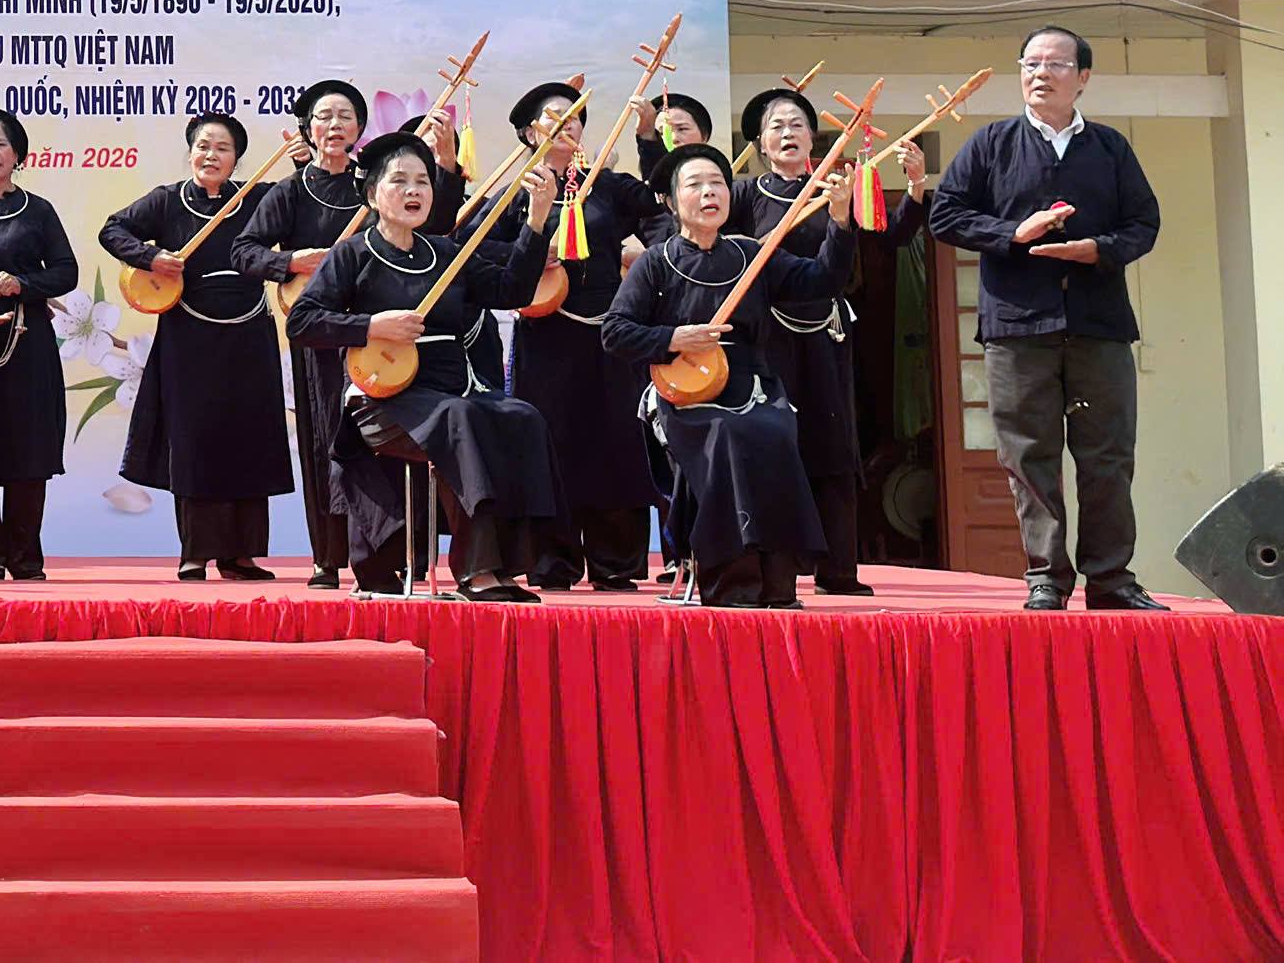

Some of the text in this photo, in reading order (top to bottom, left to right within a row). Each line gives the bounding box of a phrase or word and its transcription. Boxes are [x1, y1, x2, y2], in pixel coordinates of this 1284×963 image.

[11, 35, 67, 68] MTTQ
[74, 29, 118, 72] VIỆT
[125, 35, 174, 65] NAM
[5, 75, 69, 119] QUỐC,
[75, 79, 145, 121] NHIỆM
[152, 79, 178, 115] KỲ
[185, 85, 236, 115] 2026
[257, 85, 306, 115] 203
[24, 146, 74, 169] năm
[81, 147, 139, 169] 2026
